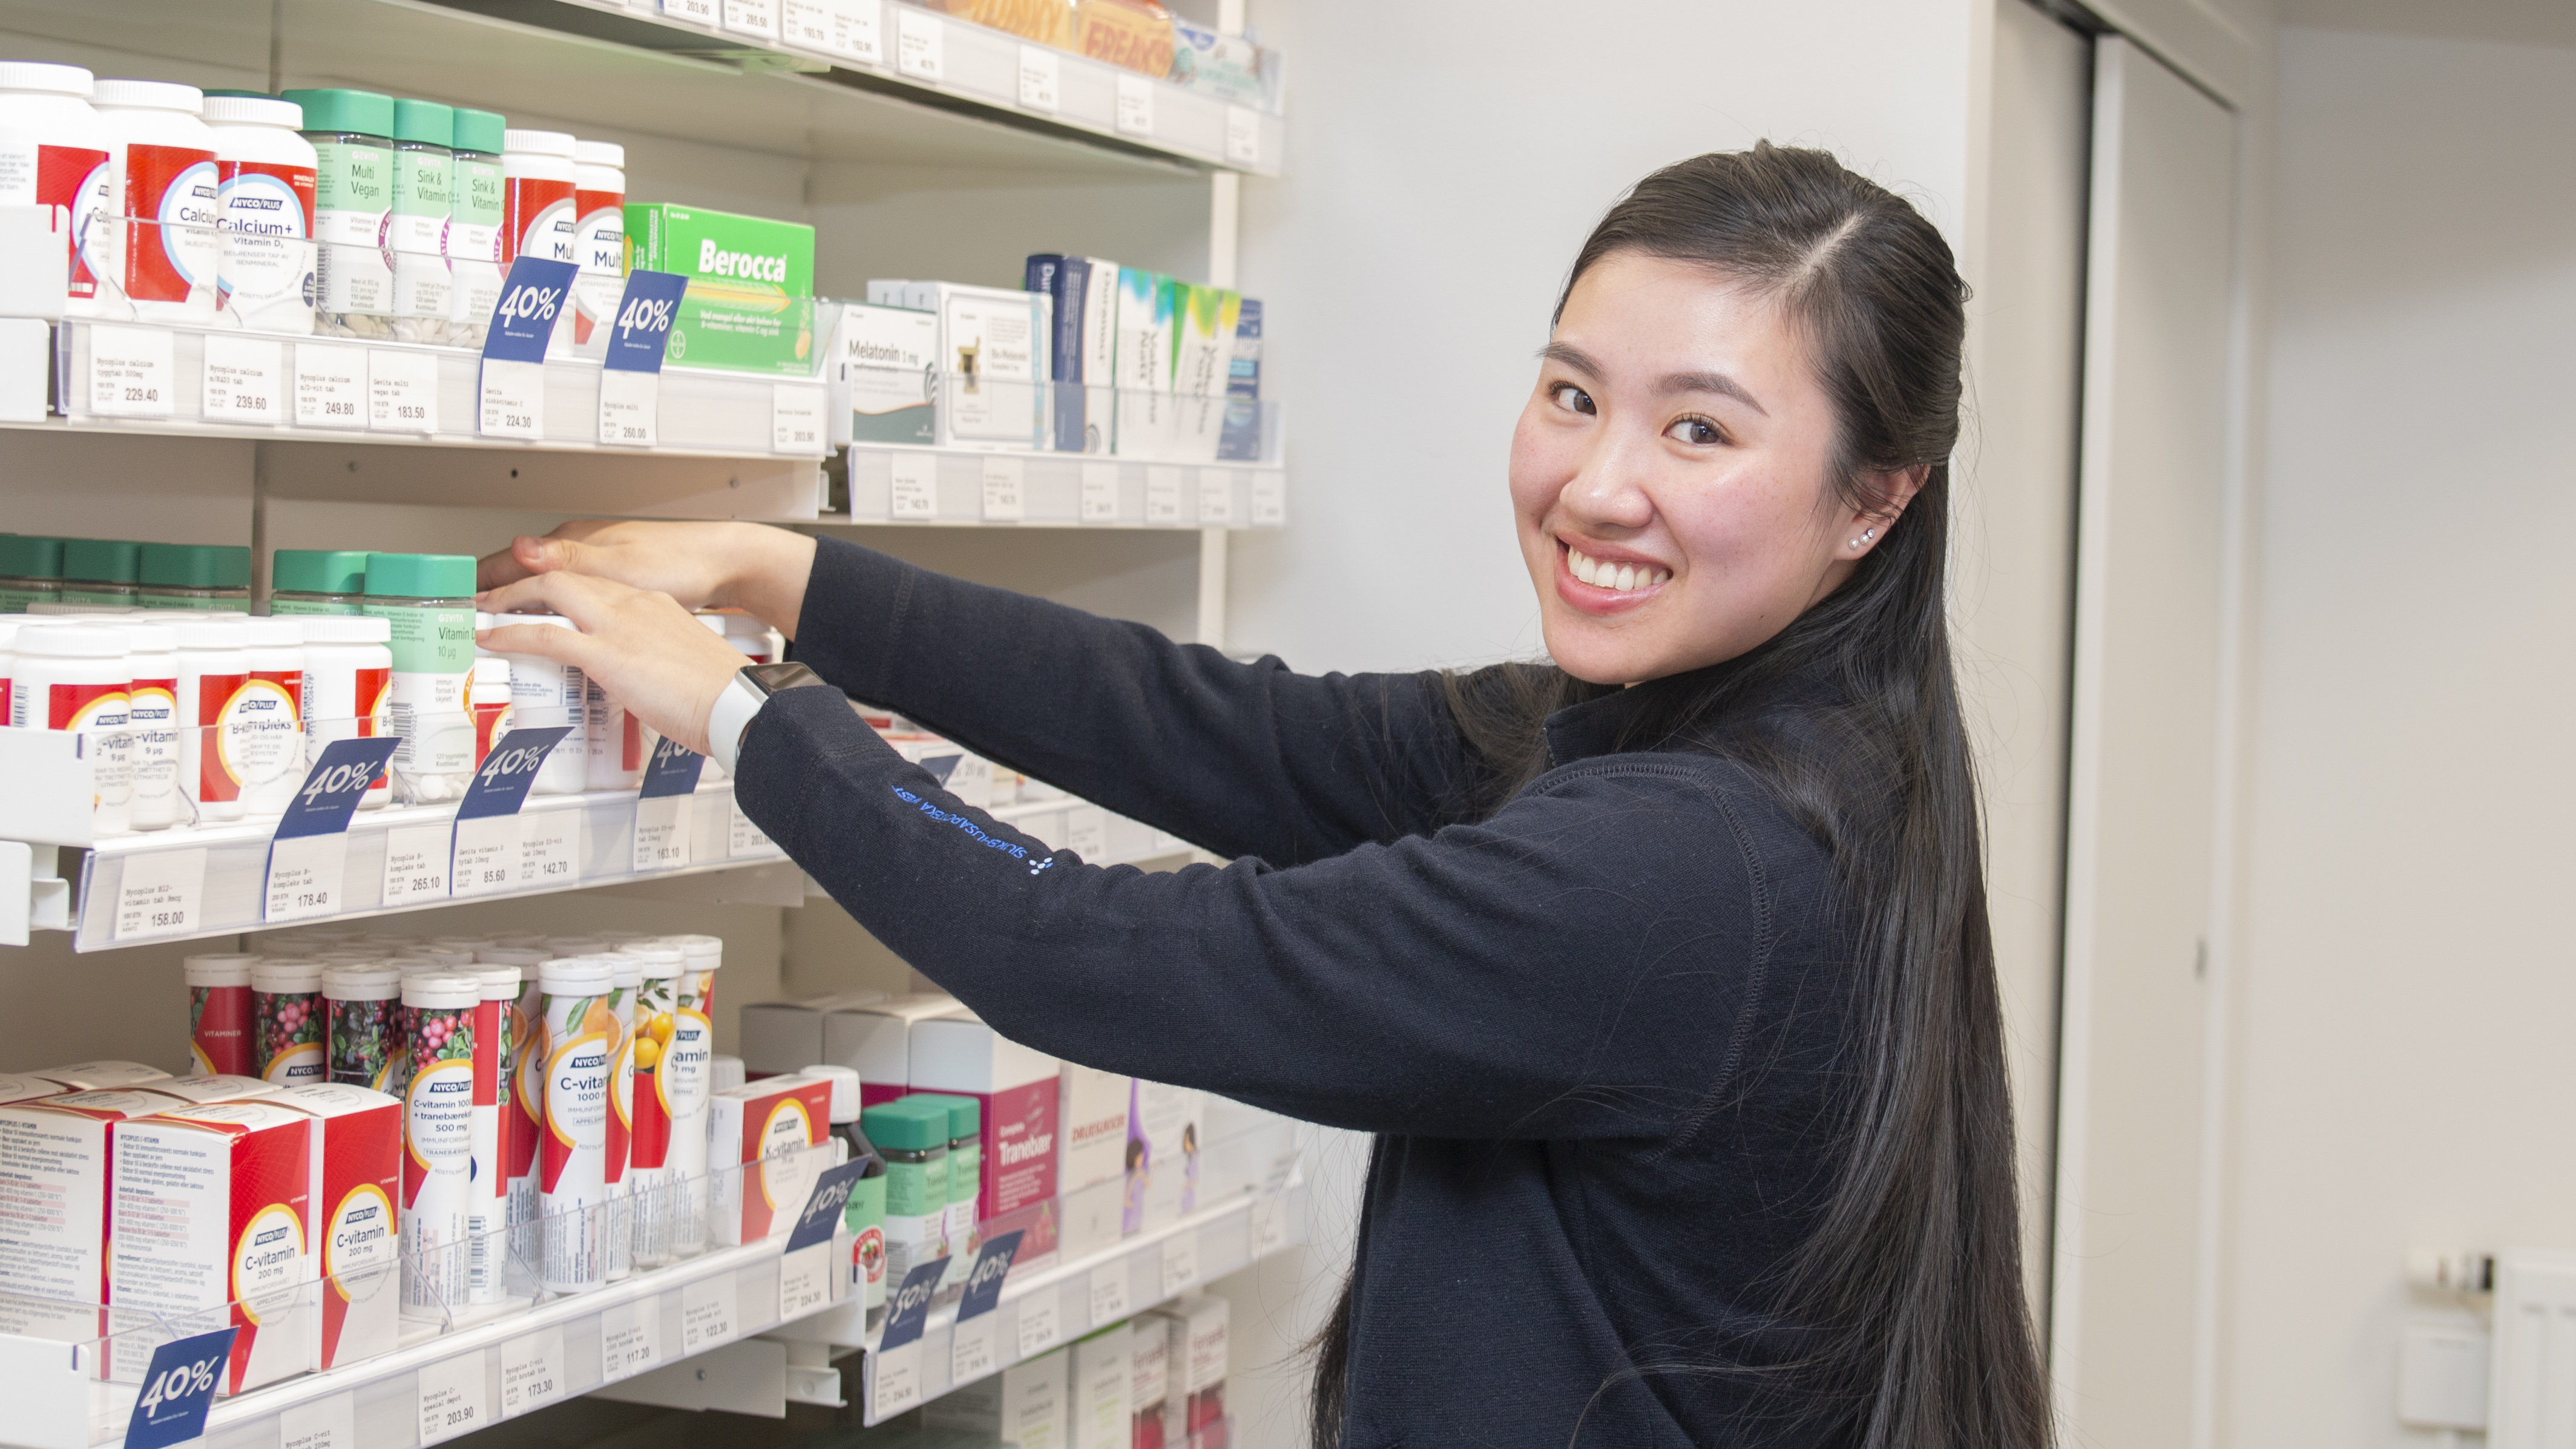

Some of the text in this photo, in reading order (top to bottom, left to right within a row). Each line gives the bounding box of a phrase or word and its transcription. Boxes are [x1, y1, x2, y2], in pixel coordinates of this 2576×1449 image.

[746, 13, 767, 28] 285.50
[352, 151, 380, 162] GEVITA
[418, 156, 442, 168] GEVITA
[352, 163, 375, 180] Multi
[418, 169, 435, 184] Sink
[351, 181, 380, 199] Vegan
[473, 179, 488, 193] Sink
[418, 186, 447, 203] Vitamin
[472, 195, 499, 211] Vitamin
[217, 218, 293, 235] Calcium+
[350, 216, 372, 225] Vitaminer
[350, 225, 372, 234] mineraler
[234, 237, 271, 247] Vitamin
[223, 250, 266, 258] BEGRENSER
[698, 238, 787, 283] Berocca
[499, 284, 561, 328] 40%
[618, 298, 674, 340] 40%
[849, 340, 919, 367] Melatonin mg
[97, 369, 143, 380] tyggtab 500mg
[240, 367, 263, 377] calcium
[126, 387, 159, 402] 229.40
[486, 387, 502, 396] Gevita
[236, 395, 267, 410] 239.60
[326, 402, 355, 415] 249.80
[398, 406, 425, 419] 183.50
[506, 415, 531, 429] 224.30
[623, 427, 646, 439] 260.00
[795, 431, 815, 442] 203.90
[438, 613, 464, 623] GEVITA
[438, 627, 470, 642] Vitamin
[438, 646, 456, 660] 10 µg
[481, 744, 550, 787] 40%
[303, 760, 378, 806] 40%
[891, 784, 922, 804] VEST
[639, 826, 660, 835] Nycoplus
[459, 846, 499, 856] Gevita vitamin
[522, 840, 544, 849] Nycoplus
[390, 854, 415, 862] Nycoplus
[533, 849, 547, 857] 10mcg
[657, 846, 680, 859] 163.10
[475, 856, 490, 864] 10mcg
[274, 869, 301, 879] Nycoplus
[390, 864, 414, 873] kompleks
[542, 861, 568, 875] 142.70
[484, 869, 505, 883] 85.60
[125, 884, 173, 896] Nycoplus B12-
[273, 879, 300, 889] kompleks
[412, 876, 440, 892] 265.10
[125, 896, 151, 907] vitamin
[167, 895, 182, 904] 9mcg
[297, 892, 328, 908] 178.40
[151, 911, 185, 928] 158.00
[414, 1099, 456, 1109] C-vitamin
[577, 1092, 600, 1102] 1000
[436, 1123, 467, 1132] 500 mg
[999, 1133, 1053, 1167] Tranebær
[804, 1177, 855, 1224] 40%
[337, 1224, 385, 1248] C-vitamin
[349, 1243, 373, 1257] 200 mg
[245, 1246, 295, 1270] C-vitamin
[258, 1266, 284, 1280] 200 mg
[347, 1269, 380, 1284] APPELSINSMAK
[970, 1249, 1011, 1293] 40%
[256, 1292, 290, 1306] APPELSINSMAK
[801, 1290, 821, 1307] 224.30
[890, 1276, 938, 1326] 50%
[606, 1331, 626, 1342] Nycoplus
[706, 1321, 728, 1338] 122.30
[606, 1342, 617, 1352] 1000
[626, 1346, 649, 1364] 117.20
[505, 1358, 543, 1375] Nycoplus C-vit
[506, 1370, 535, 1384] 1000 brutab
[140, 1356, 220, 1419] 40%
[528, 1379, 553, 1398] 173.30
[423, 1392, 448, 1403] Nycoplus
[424, 1395, 462, 1413] spesial depot
[447, 1406, 474, 1426] 203.90
[286, 1430, 330, 1449] Nycoplus C-vit
